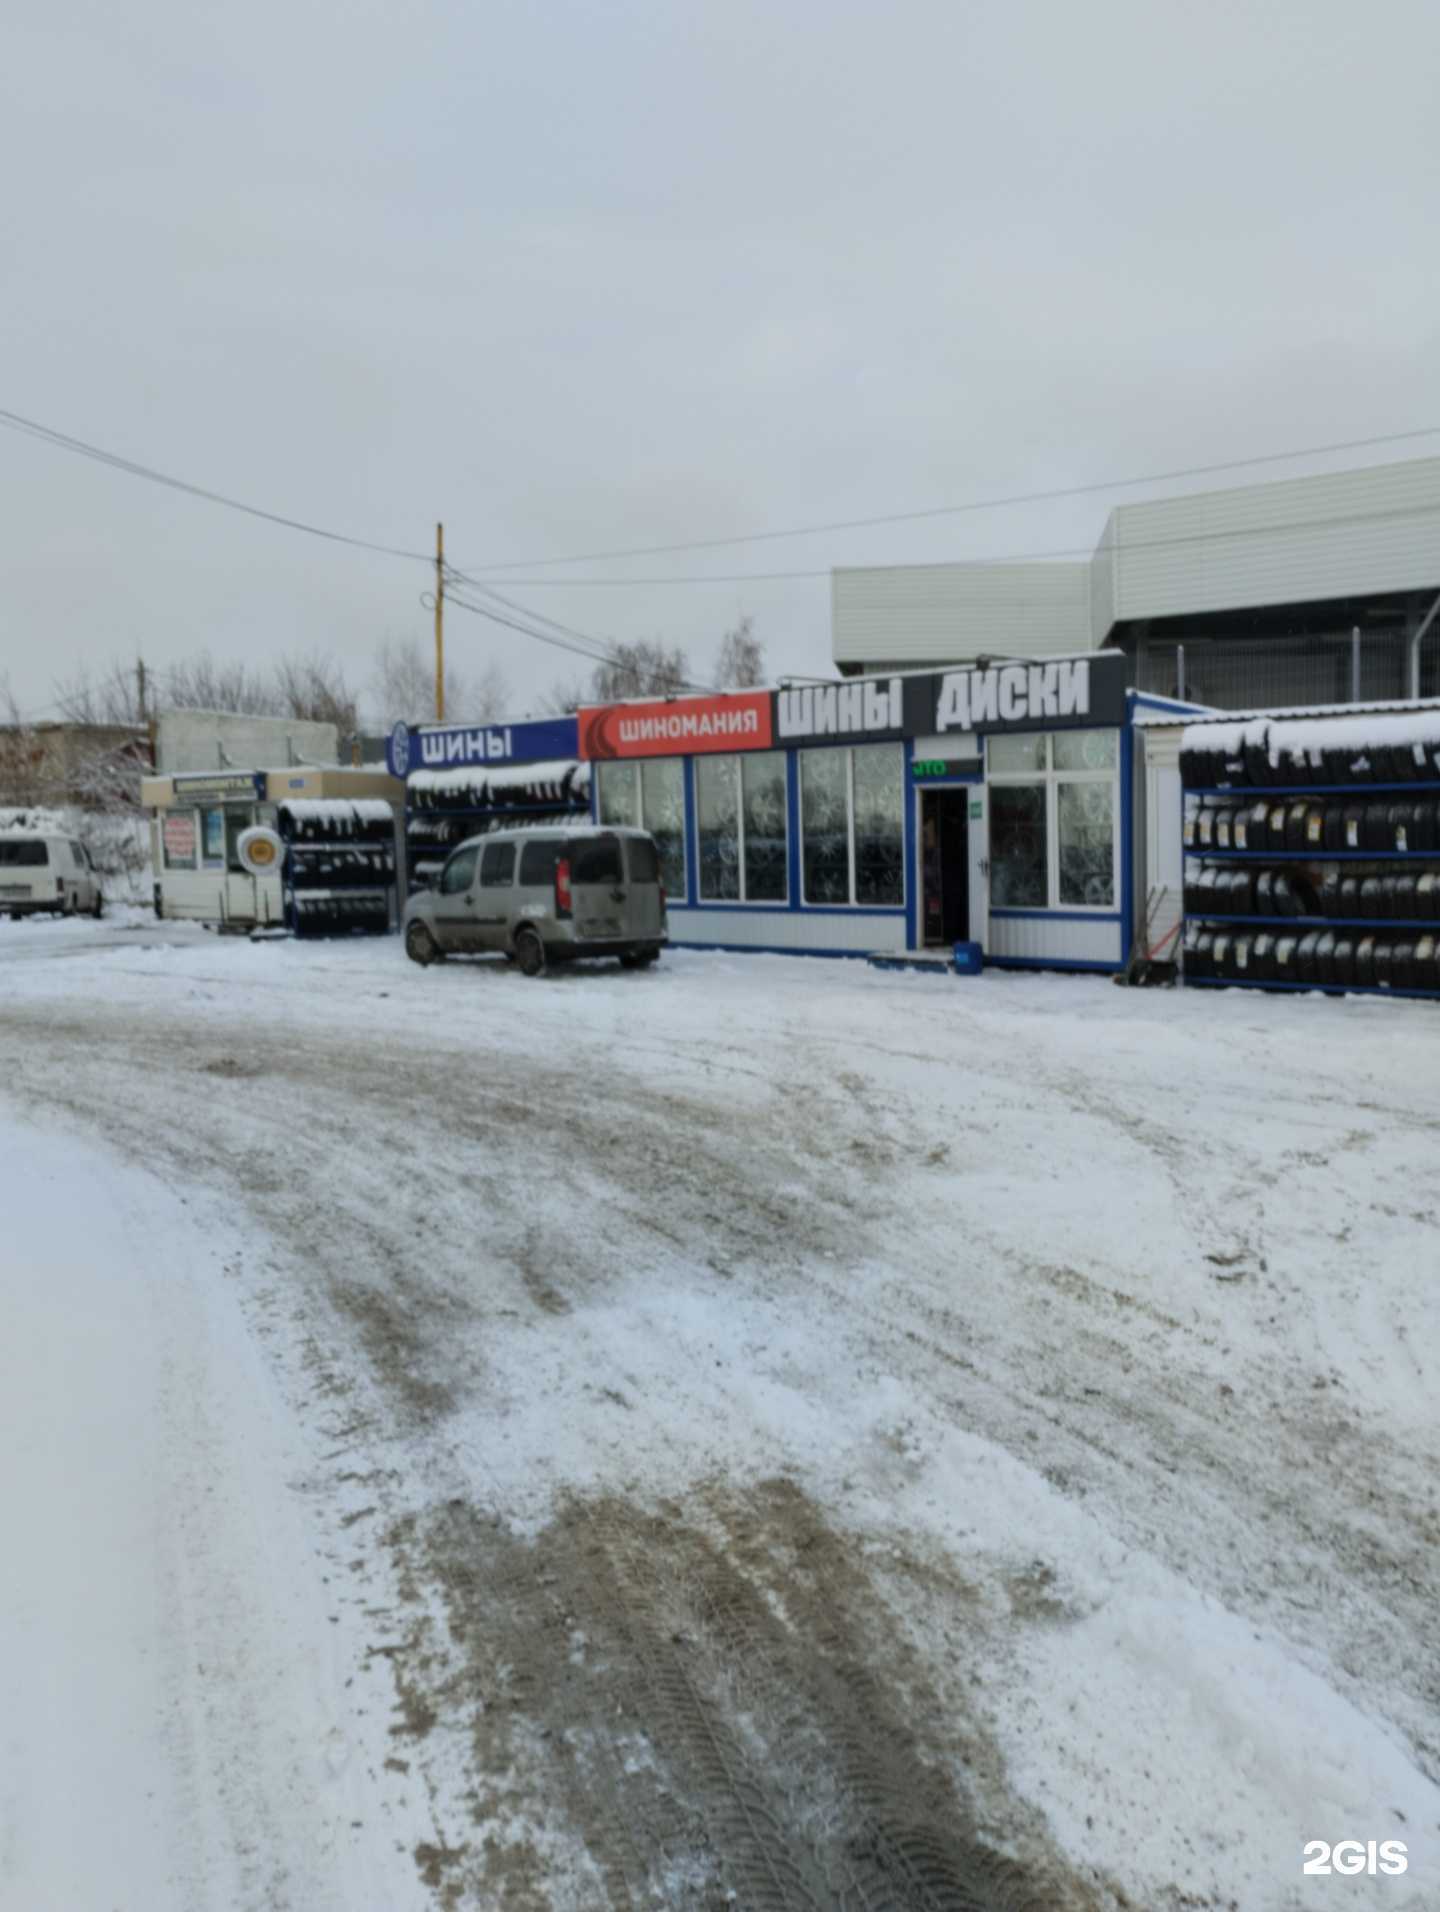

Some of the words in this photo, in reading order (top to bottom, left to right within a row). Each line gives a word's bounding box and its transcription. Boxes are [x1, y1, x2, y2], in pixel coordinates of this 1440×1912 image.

[778, 678, 903, 739] ШИНЫ
[936, 661, 1090, 733] ДИСКИ
[619, 708, 759, 742] ШИНОМАНИЯ
[421, 728, 513, 764] ШИНЫ
